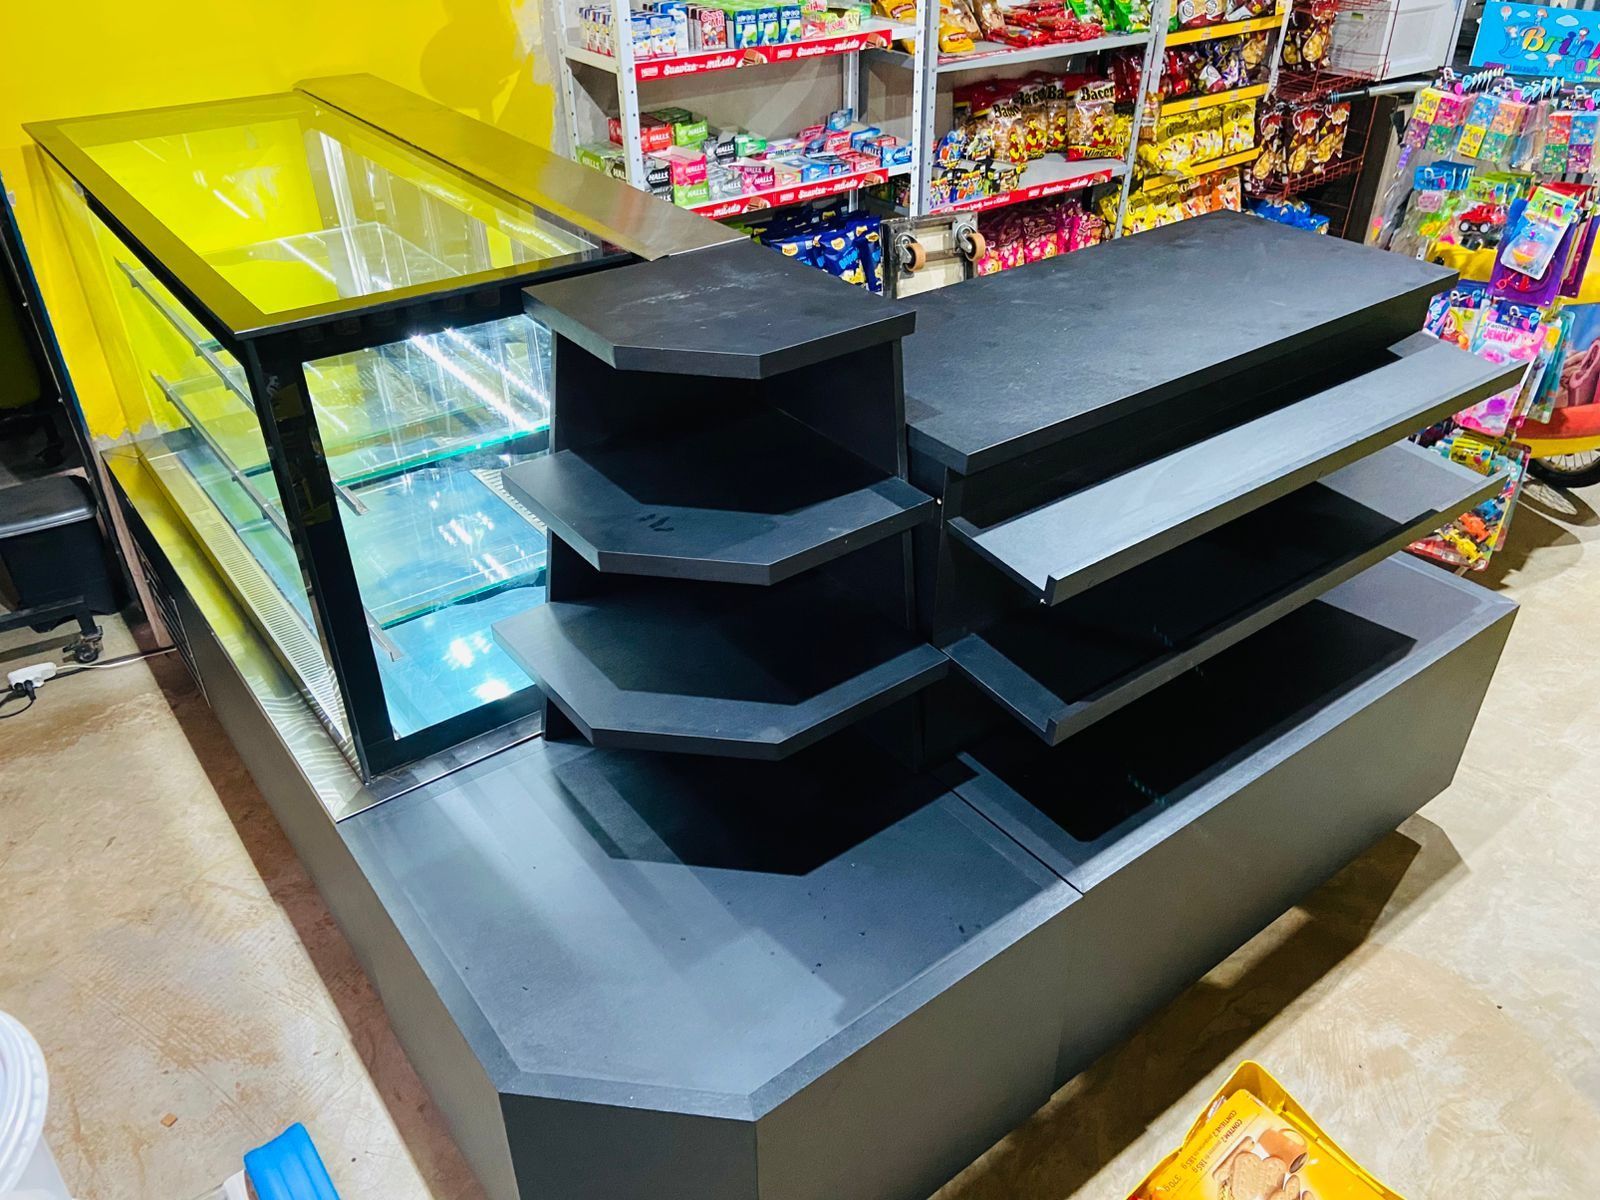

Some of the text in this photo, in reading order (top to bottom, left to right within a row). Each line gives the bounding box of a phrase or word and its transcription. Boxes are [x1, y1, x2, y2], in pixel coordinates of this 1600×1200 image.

[650, 133, 670, 142] HALLS
[716, 144, 734, 154] HALLS
[863, 146, 881, 157] HALLS
[648, 171, 669, 181] HALLS
[754, 175, 773, 185] HALLS
